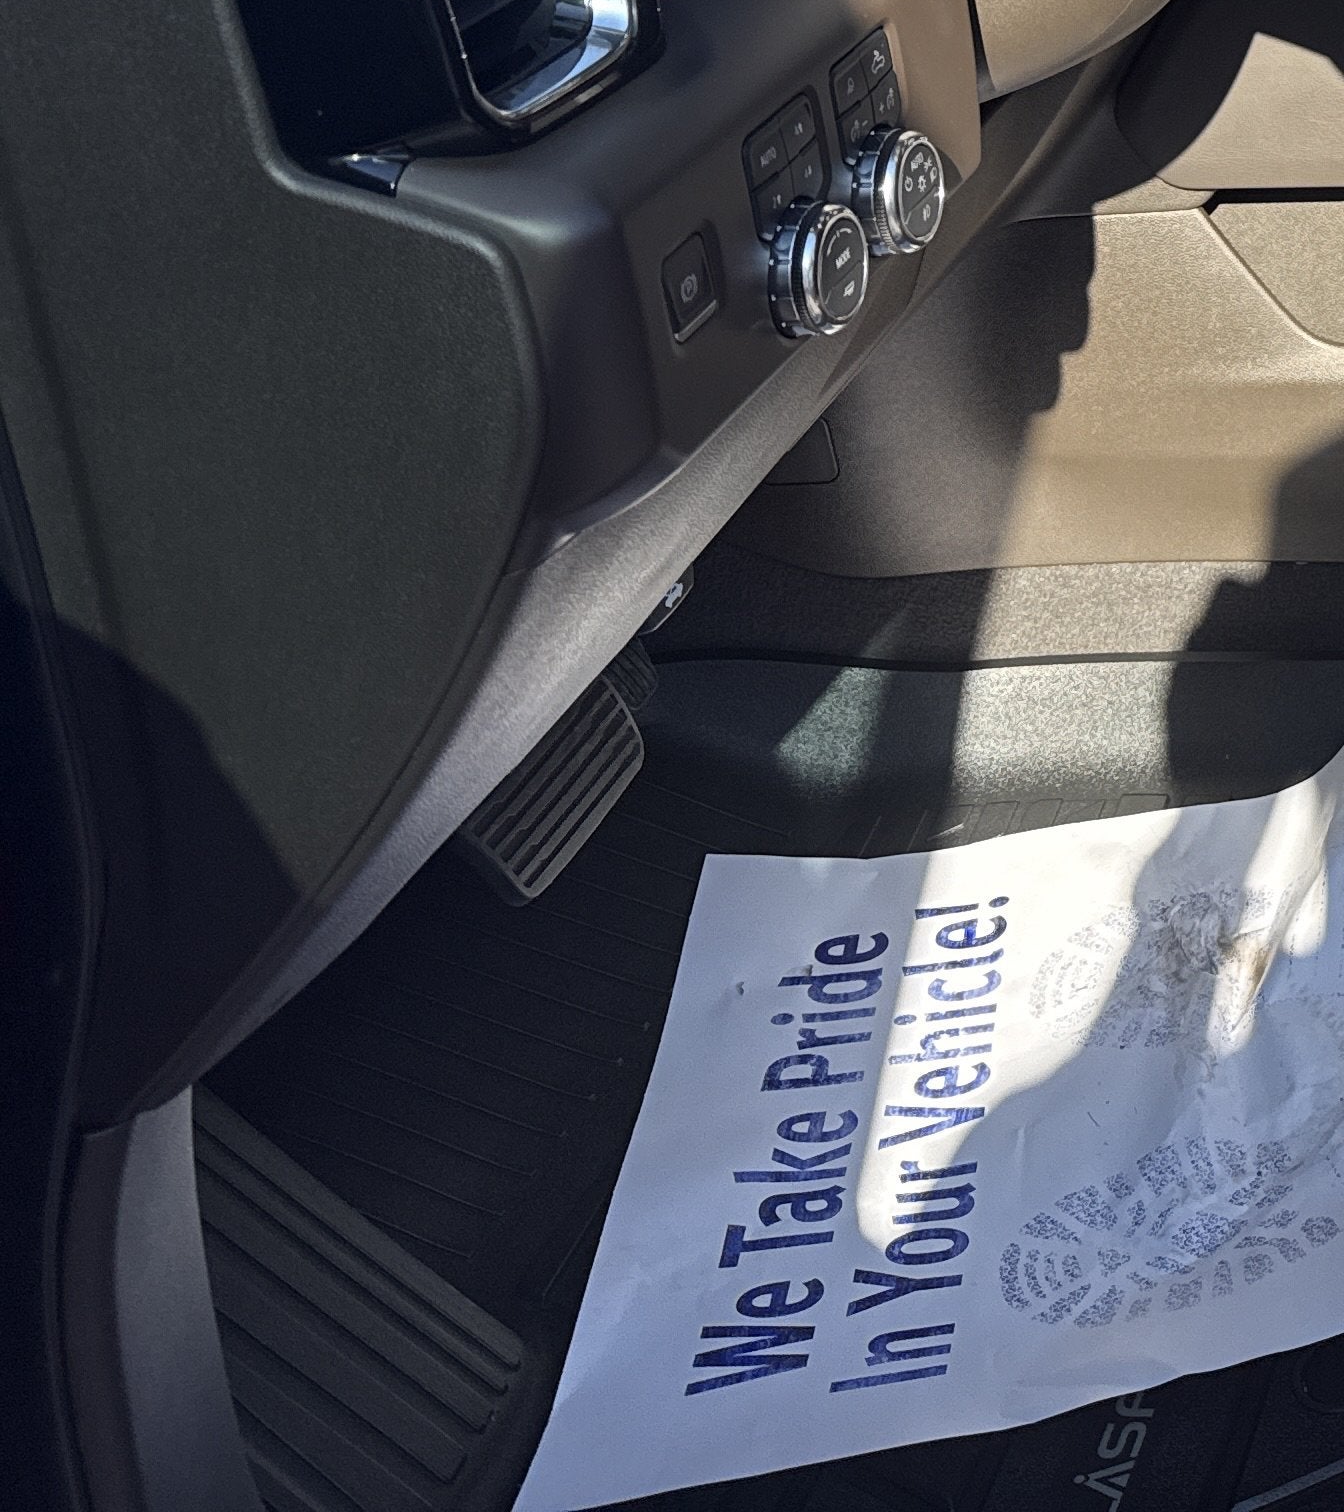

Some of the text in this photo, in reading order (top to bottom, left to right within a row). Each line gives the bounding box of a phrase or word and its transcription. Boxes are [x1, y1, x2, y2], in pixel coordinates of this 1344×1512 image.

[684, 931, 889, 1396] We Take Pride
[829, 895, 1010, 1393] In Your Vehicle!
